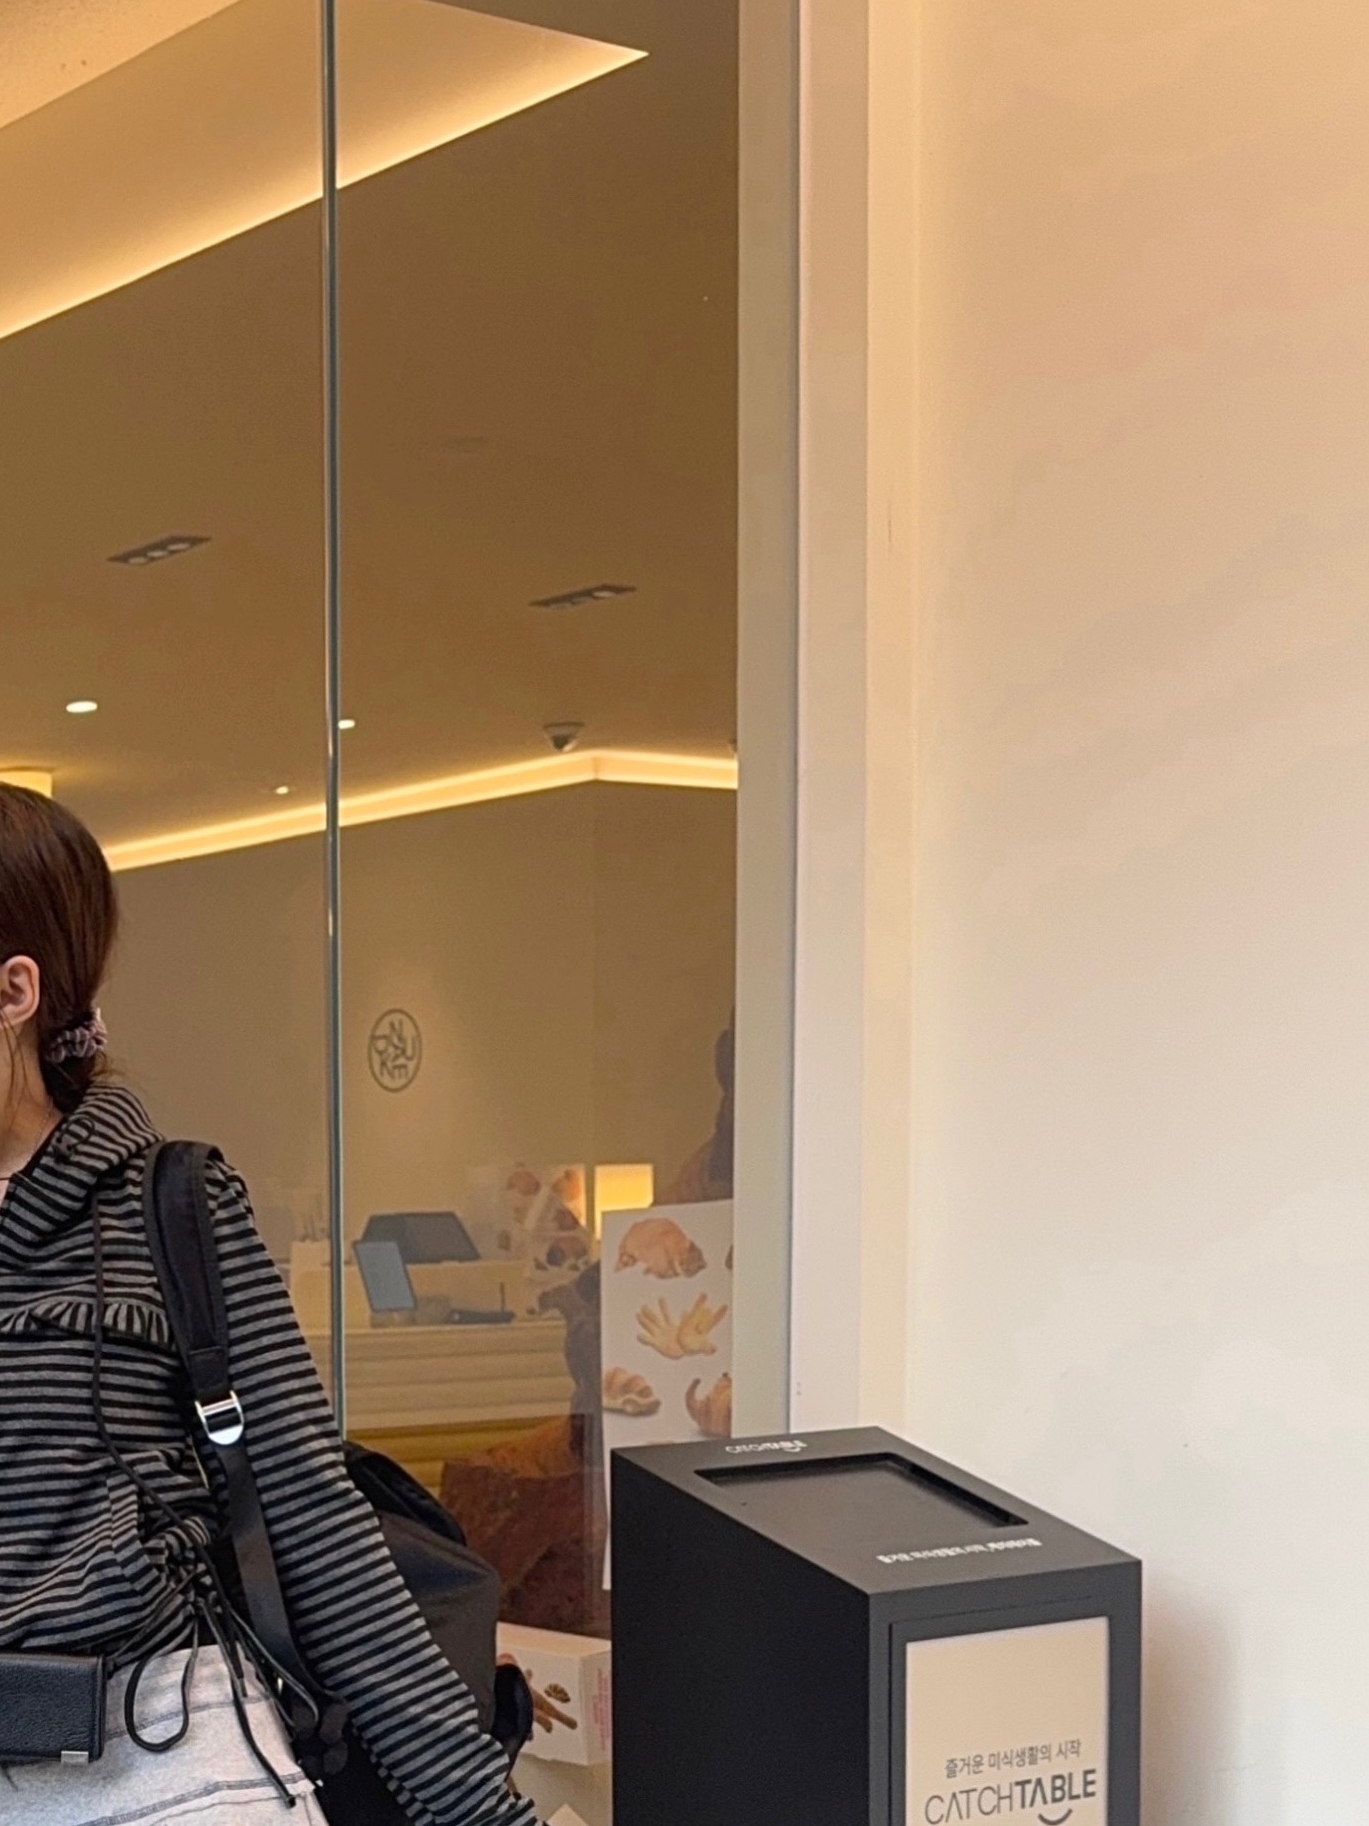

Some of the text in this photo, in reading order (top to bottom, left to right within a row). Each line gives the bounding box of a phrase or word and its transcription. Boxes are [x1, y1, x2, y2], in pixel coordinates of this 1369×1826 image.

[944, 1738, 1082, 1779] 즐거운 미식생활의 시작
[924, 1767, 1097, 1826] CATCHTABLE
